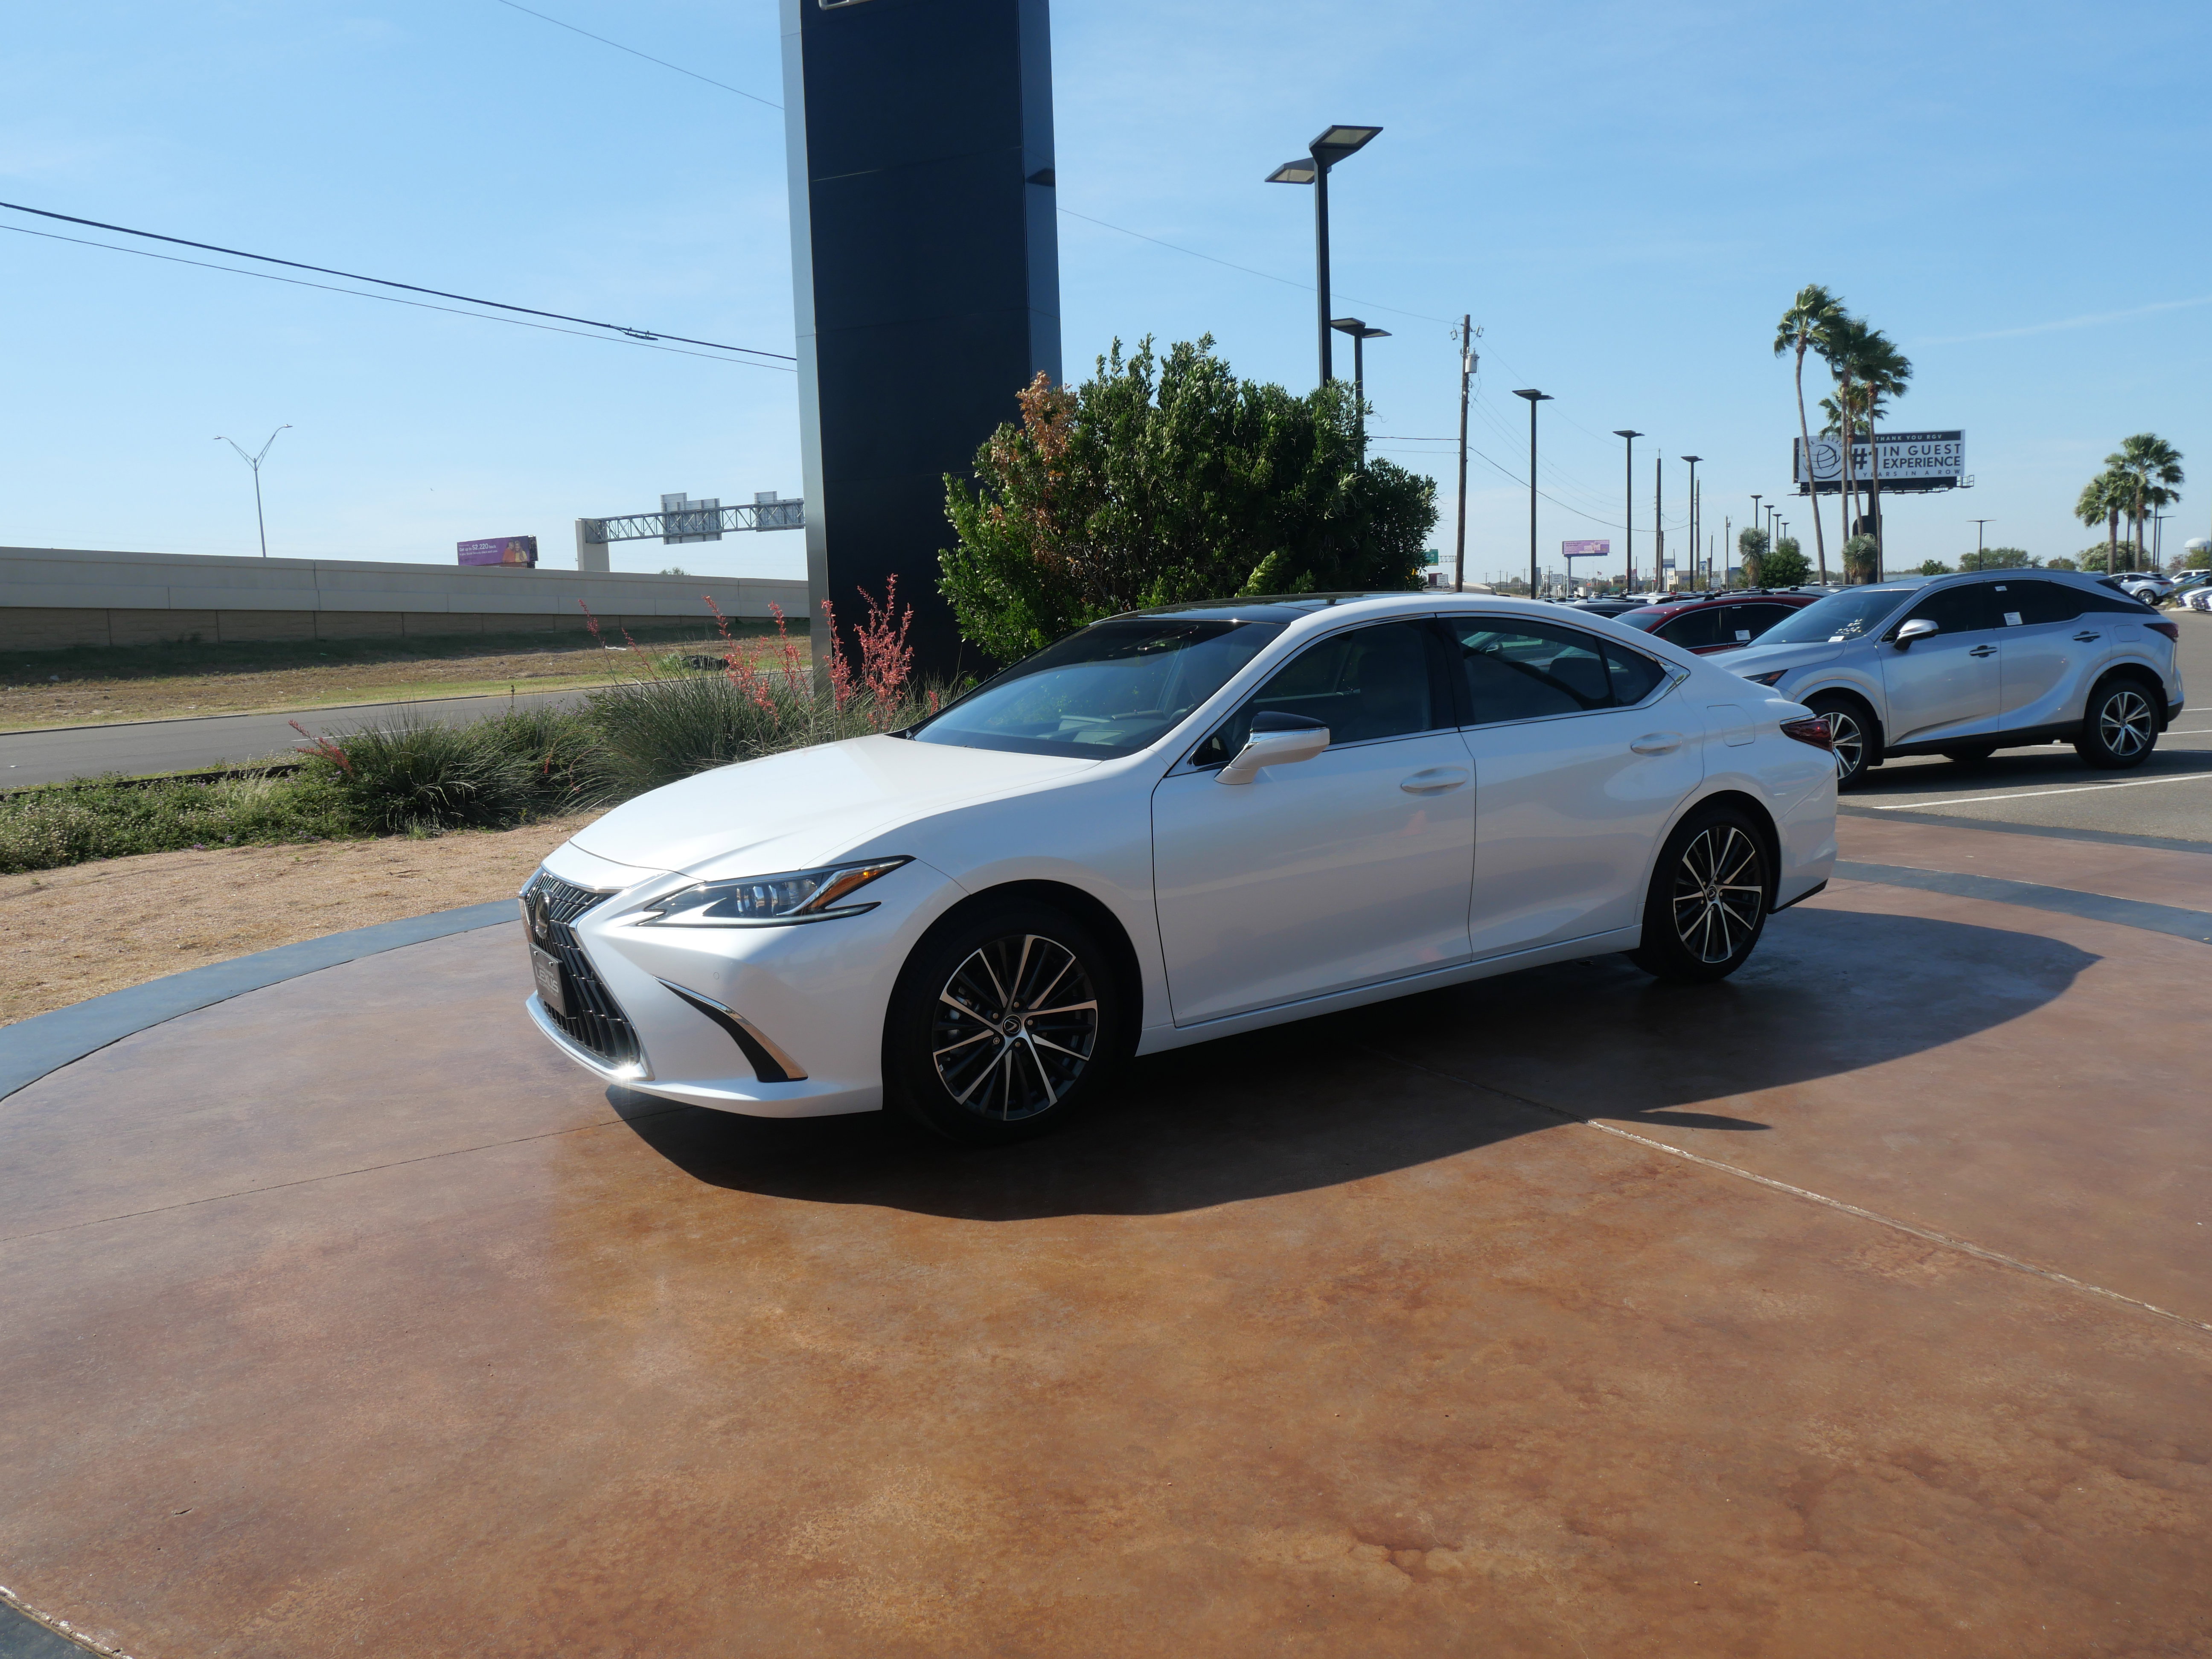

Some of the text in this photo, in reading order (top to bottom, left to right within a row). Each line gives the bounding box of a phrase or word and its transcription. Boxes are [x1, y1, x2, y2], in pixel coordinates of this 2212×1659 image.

[1827, 436, 1843, 451] LEXU
[1883, 444, 1961, 457] IN GUEST
[1883, 456, 1961, 469] EXPERIENCE
[535, 966, 559, 993] LEXUS
